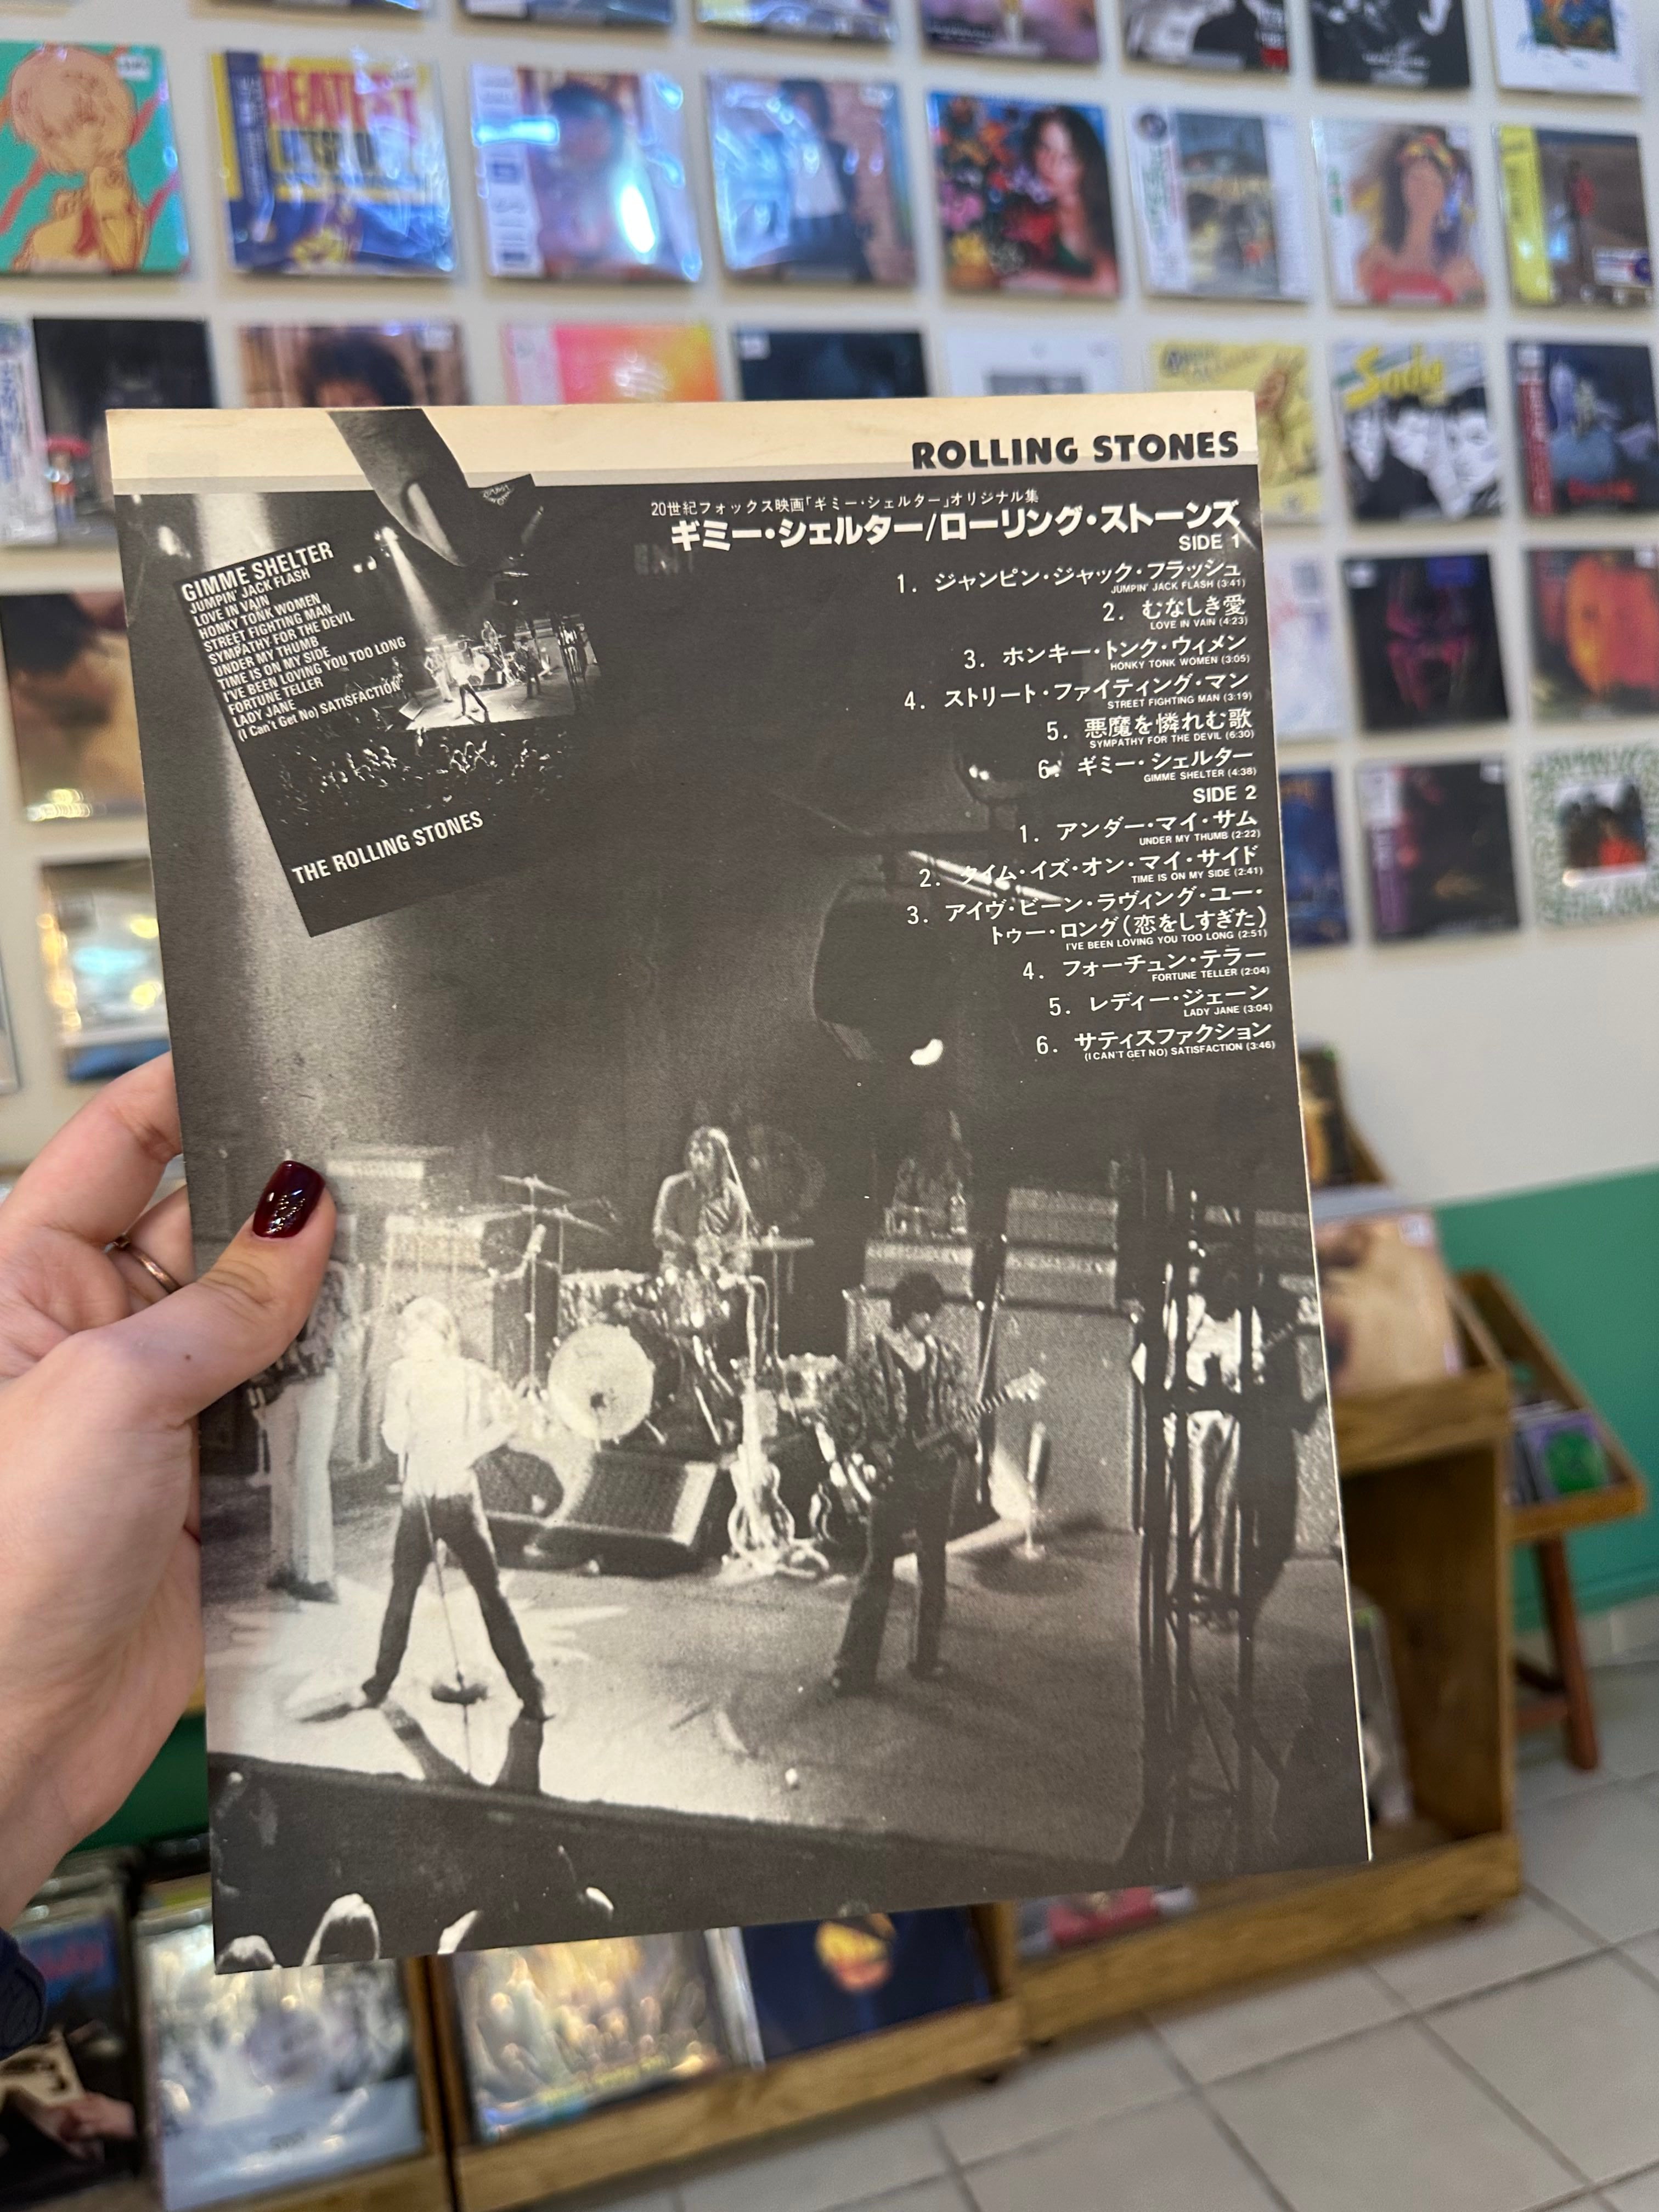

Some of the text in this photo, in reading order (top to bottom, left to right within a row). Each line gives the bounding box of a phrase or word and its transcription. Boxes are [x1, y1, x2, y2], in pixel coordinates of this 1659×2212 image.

[912, 431, 1239, 470] ROLLING STONES
[1179, 533, 1242, 550] SIDE 1
[181, 541, 333, 601] GIMME SHELTER
[190, 568, 310, 614] JUMPIN' JACK FLASH
[898, 574, 916, 593] 1.
[1111, 579, 1245, 593] JUMPIN' JACK FLASH (3:41)
[194, 594, 269, 627] LOVE IN VAIN
[199, 593, 320, 639] HONKY TONK WOMEN
[1103, 602, 1123, 621] 2.
[204, 603, 332, 652] STREET FIGHTING MAN
[1150, 620, 1176, 630] LOVE
[1193, 618, 1215, 627] VAIN
[1219, 616, 1247, 626] (4:23)
[208, 611, 354, 664] SYMPATHY FOR THE DEVIL
[213, 636, 319, 676] UNDER MY THUMB
[964, 649, 984, 669] 3.
[1110, 654, 1249, 670] HONKY TONK WOMEN (3:05)
[217, 646, 330, 690] TIME IS ON MY SIDE
[223, 636, 405, 702] I'VE BEEN LOVING YOU TOO LONG
[228, 677, 324, 715] FORTUNE TELLER
[904, 691, 924, 709] 4.
[1107, 692, 1251, 709] STREET FIGHTING MAN (3:19)
[233, 699, 296, 727] LADY JANE
[249, 720, 278, 736] Can't
[278, 714, 298, 726] Get
[298, 706, 318, 720] No)
[319, 680, 400, 714] SATISFACTION
[1047, 721, 1067, 740] 5.
[1090, 730, 1254, 747] SYMPATHY FOR THE DEVIL (6:30)
[1143, 767, 1256, 782] GIMME SHELTER (4:38)
[1193, 785, 1256, 803] SIDE 2
[1020, 825, 1039, 843] 1.
[1139, 836, 1171, 845] UNDER
[1194, 831, 1228, 840] THUMB
[1231, 829, 1260, 839] (2:22)
[292, 810, 484, 884] THE ROLLING STONES
[919, 868, 941, 887] 2.
[1131, 874, 1154, 883] TIME
[1189, 871, 1203, 879] MY
[1207, 868, 1230, 877] SIDE
[1234, 867, 1262, 877] (2:41)
[907, 905, 928, 924] 3.
[1066, 929, 1267, 950] I'VE BEEN LOVING YOU TOO LONG (2:51)
[1023, 962, 1043, 979] 4.
[1152, 966, 1269, 981] FORTUNE TELLER (2:04)
[1049, 997, 1070, 1015] 5.
[1183, 1003, 1272, 1017] LADY JANE (3:04)
[1036, 1035, 1057, 1054] 6.
[1084, 1041, 1275, 1061] (I CAN'T GET NO) SATISFACTION (3:46)
